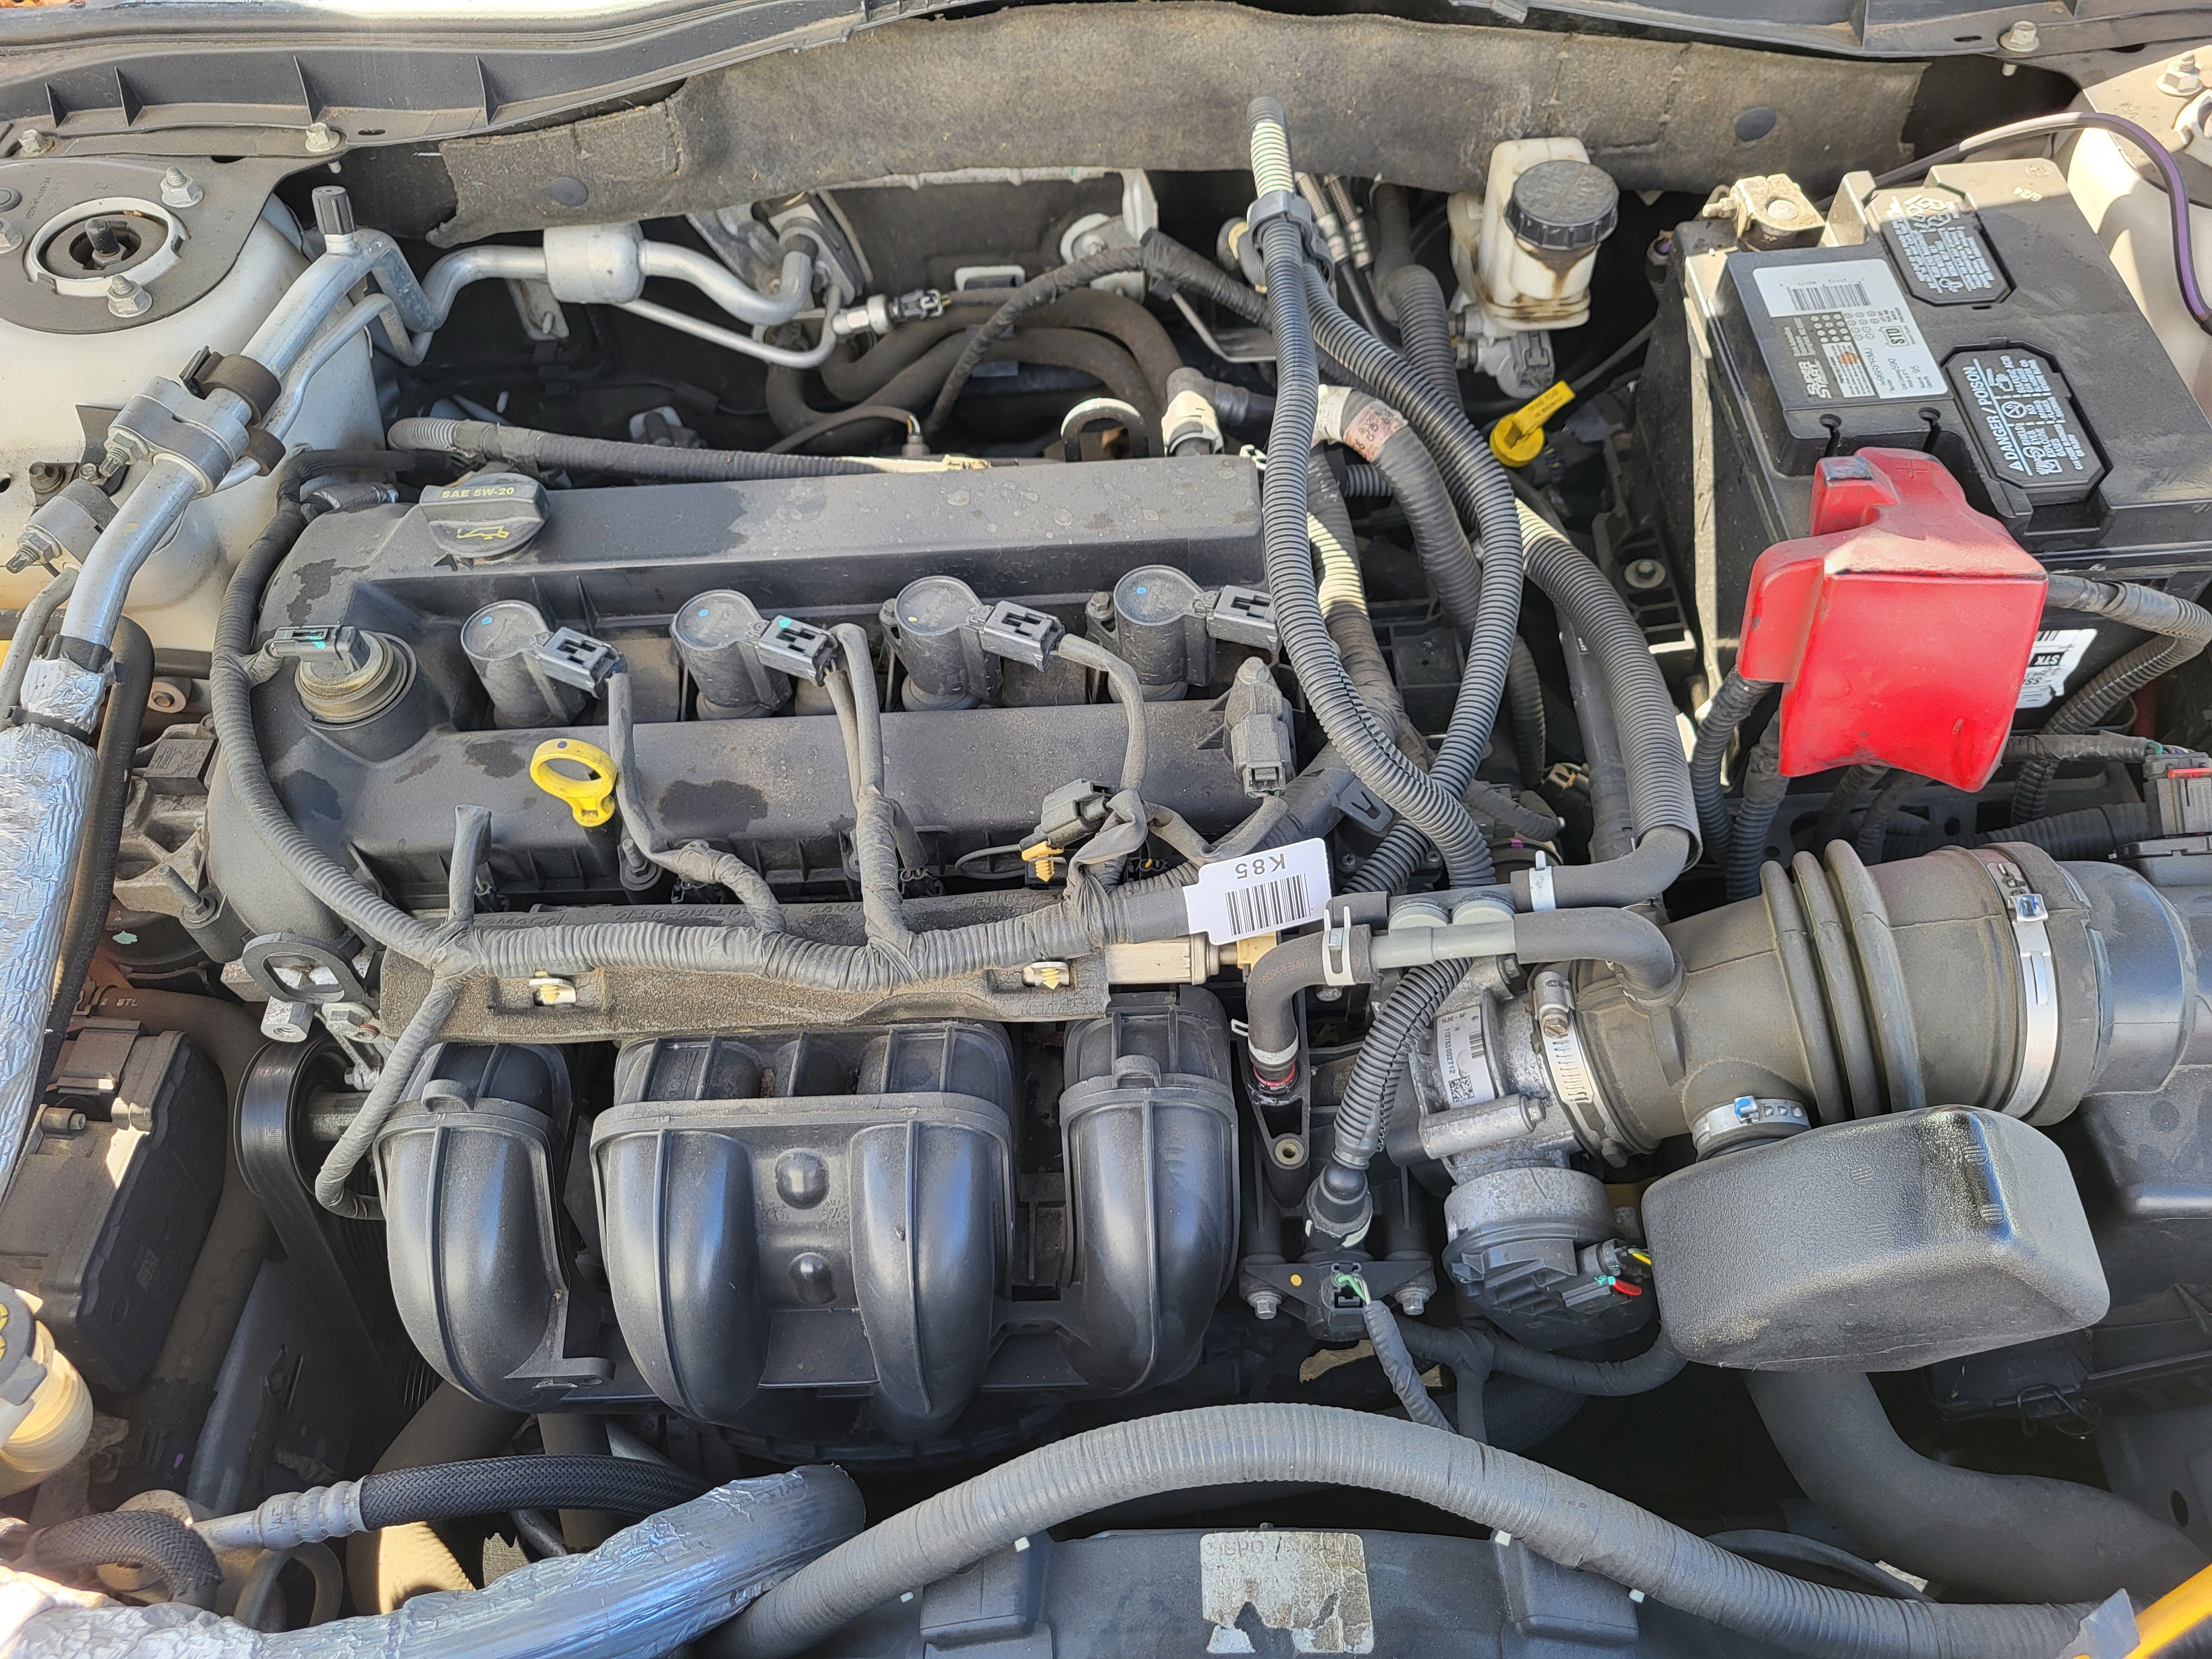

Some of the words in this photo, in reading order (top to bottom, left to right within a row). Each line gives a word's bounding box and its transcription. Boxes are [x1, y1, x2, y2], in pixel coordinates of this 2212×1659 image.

[1885, 327, 1905, 344] STD
[1999, 355, 2015, 368] ACID
[1798, 361, 1818, 395] SUPER
[1811, 359, 1832, 399] START
[1960, 366, 1993, 405] POISON
[2024, 404, 2038, 415] NO
[1984, 415, 2020, 460] DANGER
[2013, 426, 2031, 445] SHIELD
[2025, 429, 2041, 445] EYES
[2034, 427, 2057, 457] EXPLOSIVE
[2049, 438, 2067, 457] GASES
[442, 489, 470, 498] SAE
[473, 487, 515, 497] 5W-20
[2033, 654, 2060, 665] STK
[1235, 853, 1286, 880] K85
[1444, 1027, 1455, 1074] 112763002712
